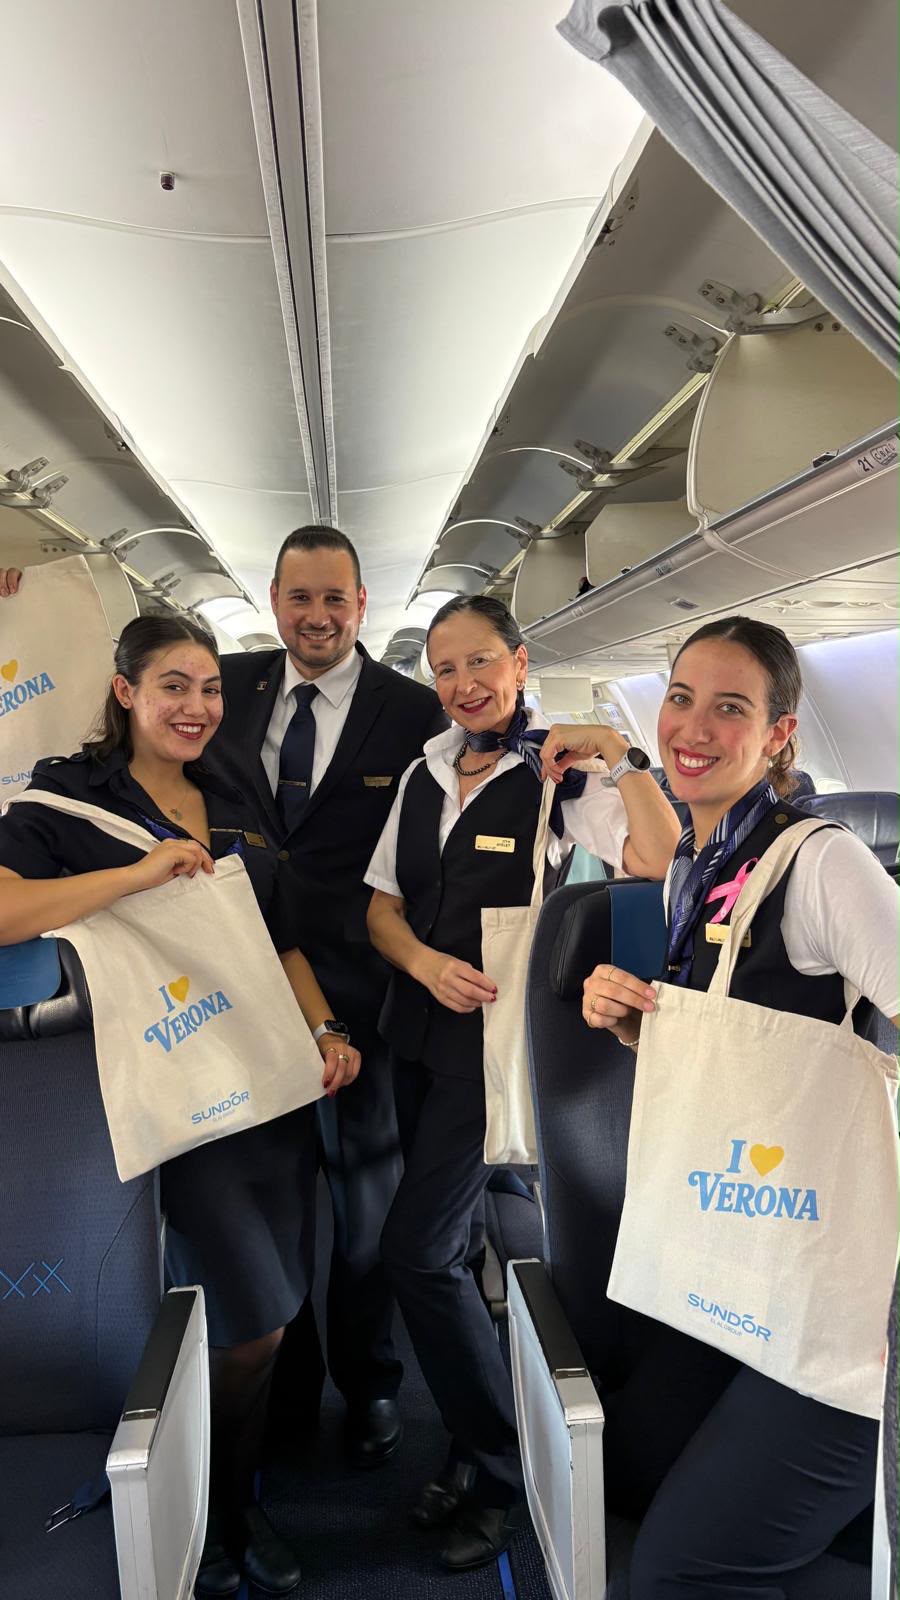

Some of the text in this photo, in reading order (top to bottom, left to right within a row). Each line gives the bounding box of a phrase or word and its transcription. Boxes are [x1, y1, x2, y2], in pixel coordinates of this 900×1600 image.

[858, 456, 874, 472] 21
[0, 672, 56, 717] RONA
[159, 985, 175, 1013] I
[144, 990, 233, 1053] VERONA
[726, 1139, 747, 1173] I
[687, 1170, 820, 1222] VERONA
